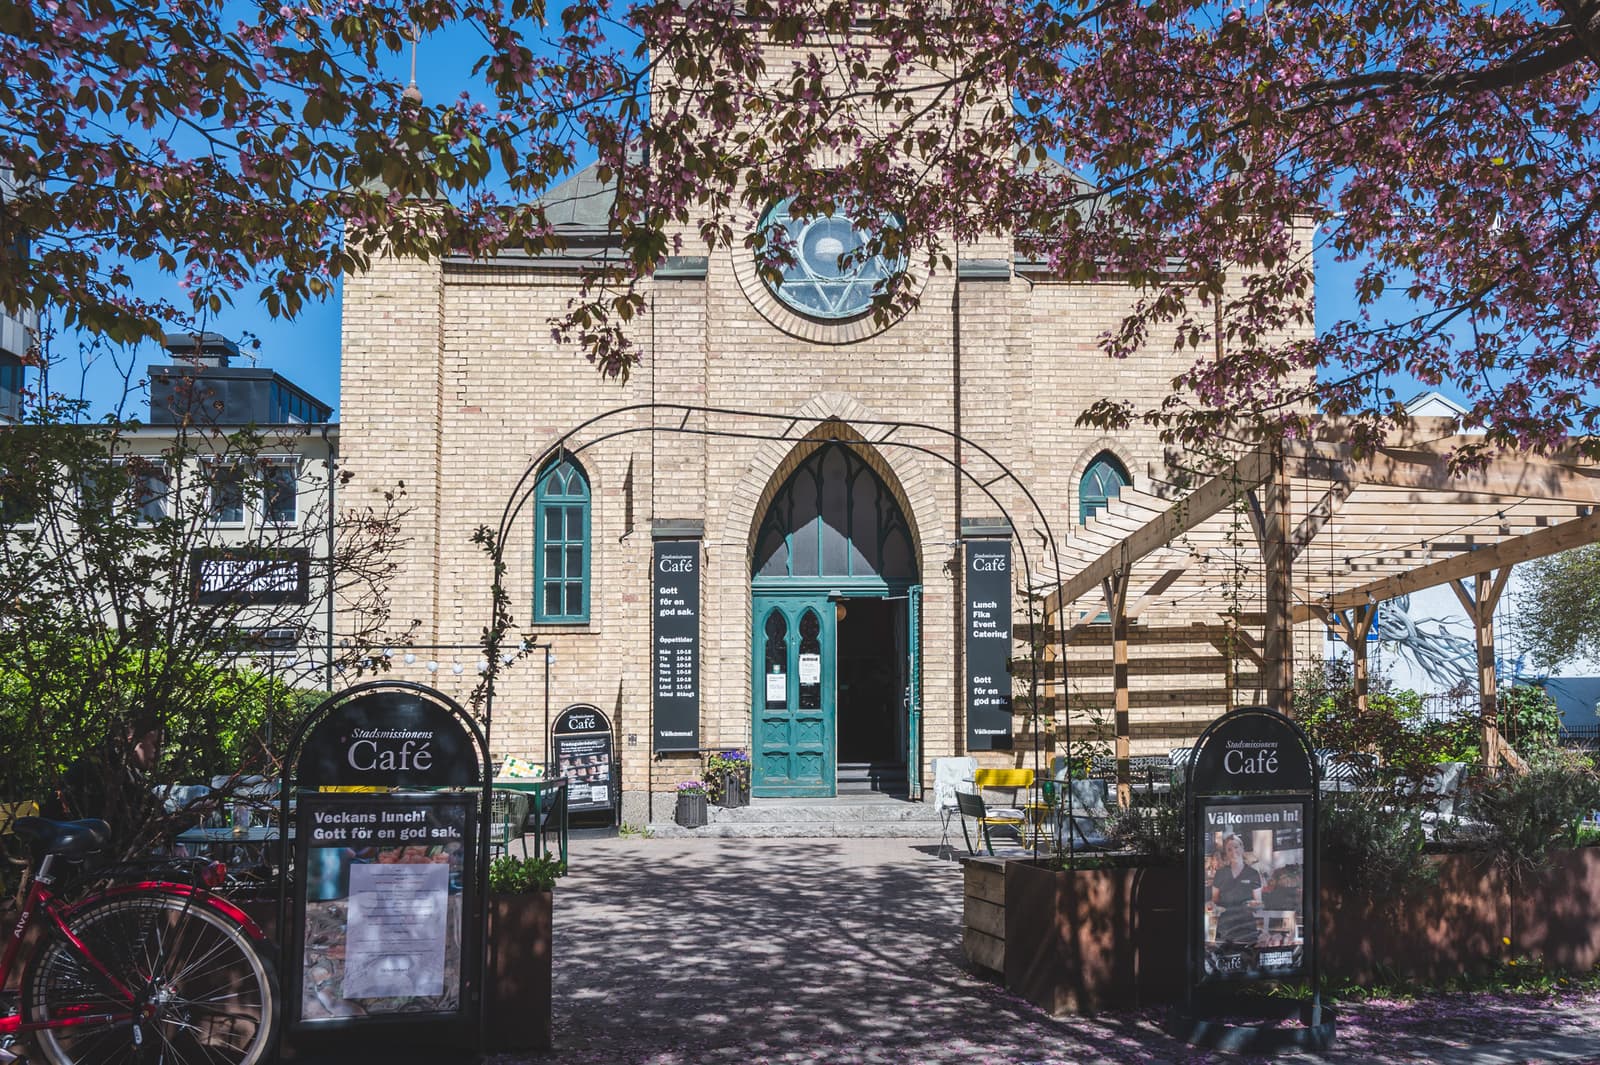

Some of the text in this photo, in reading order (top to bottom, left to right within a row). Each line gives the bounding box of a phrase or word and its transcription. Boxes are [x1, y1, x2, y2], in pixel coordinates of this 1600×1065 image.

[660, 559, 693, 572] Café
[973, 558, 1006, 572] Café
[973, 601, 997, 609] Lunch
[660, 608, 694, 617] god sak.
[973, 620, 996, 628] Event
[973, 630, 1008, 639] Catering
[974, 676, 992, 684] Gott
[974, 687, 986, 695] för
[974, 697, 989, 706] god
[568, 717, 595, 730] Café
[351, 727, 434, 740] Stadsmissionens
[347, 740, 433, 771] Café
[1223, 749, 1279, 775] Café
[314, 810, 426, 823] Veckans lunch!
[1208, 809, 1299, 825] Välkommen in!
[314, 826, 461, 840] Gott för en god sak.
